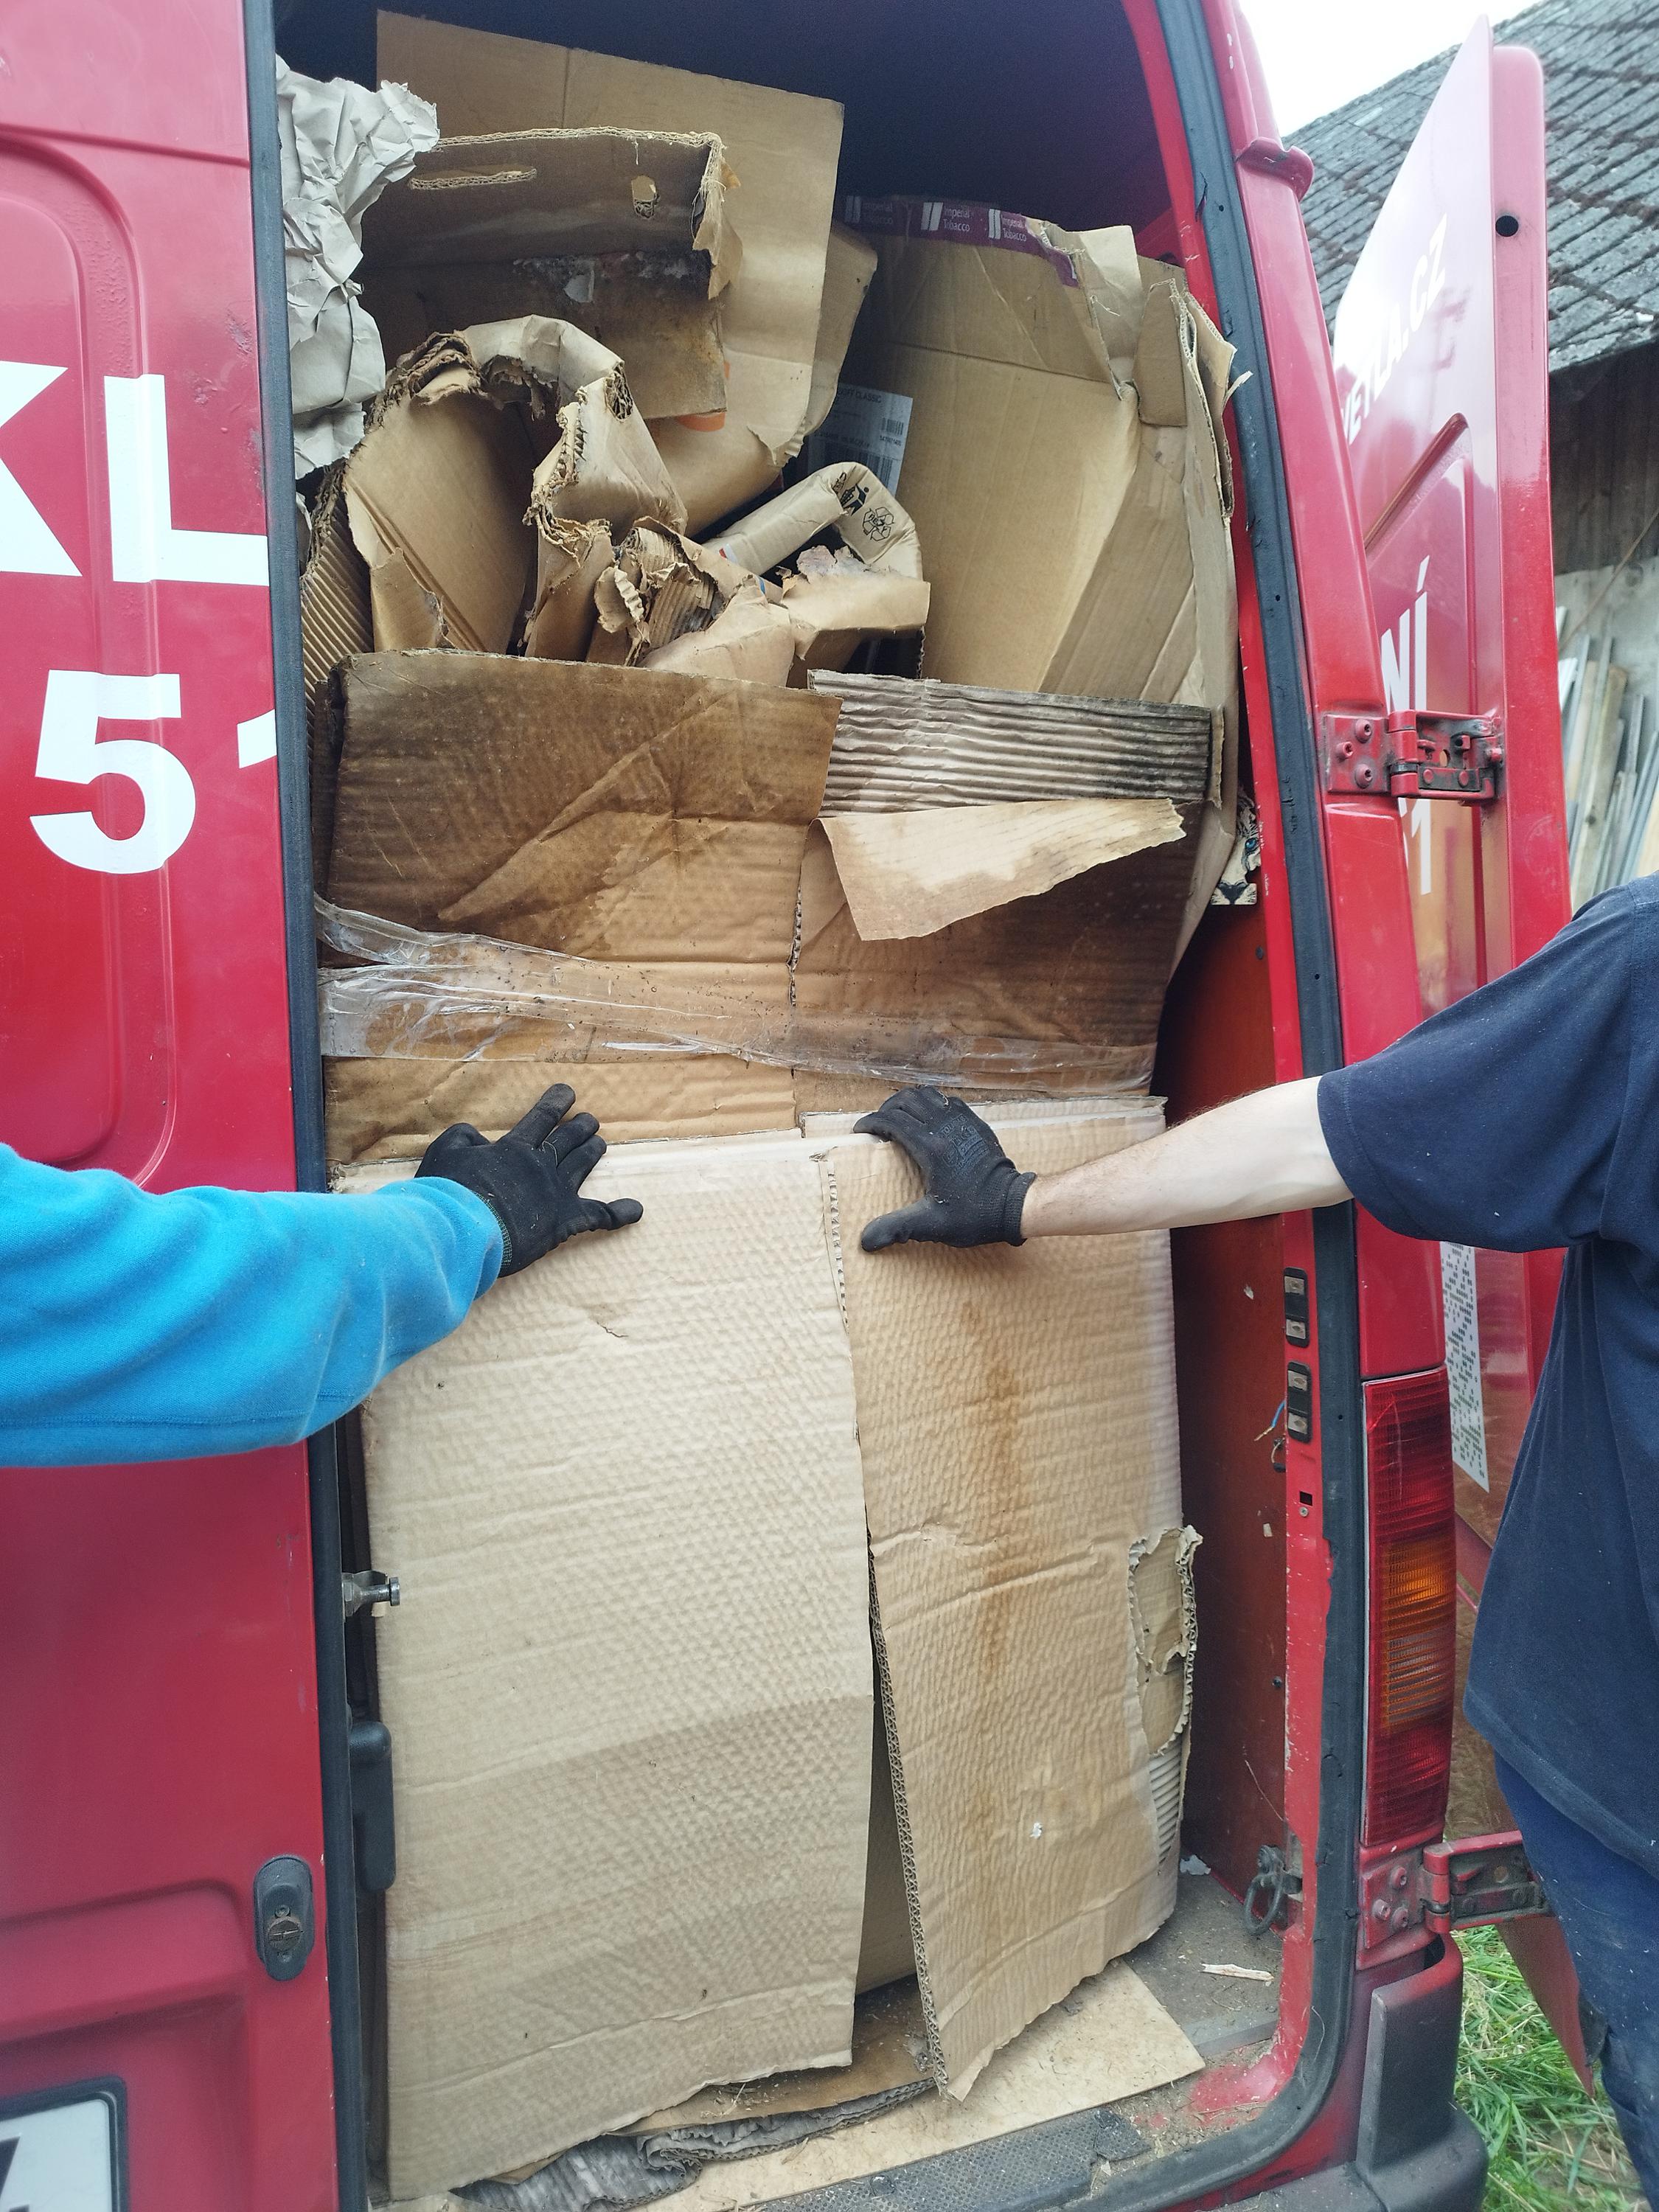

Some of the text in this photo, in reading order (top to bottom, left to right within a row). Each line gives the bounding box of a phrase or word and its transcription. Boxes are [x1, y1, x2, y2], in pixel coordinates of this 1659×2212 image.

[944, 206, 970, 219] Imperial
[943, 218, 970, 232] Tobacco
[1002, 229, 1027, 243] Tobacco
[855, 389, 883, 405] CLASSIC
